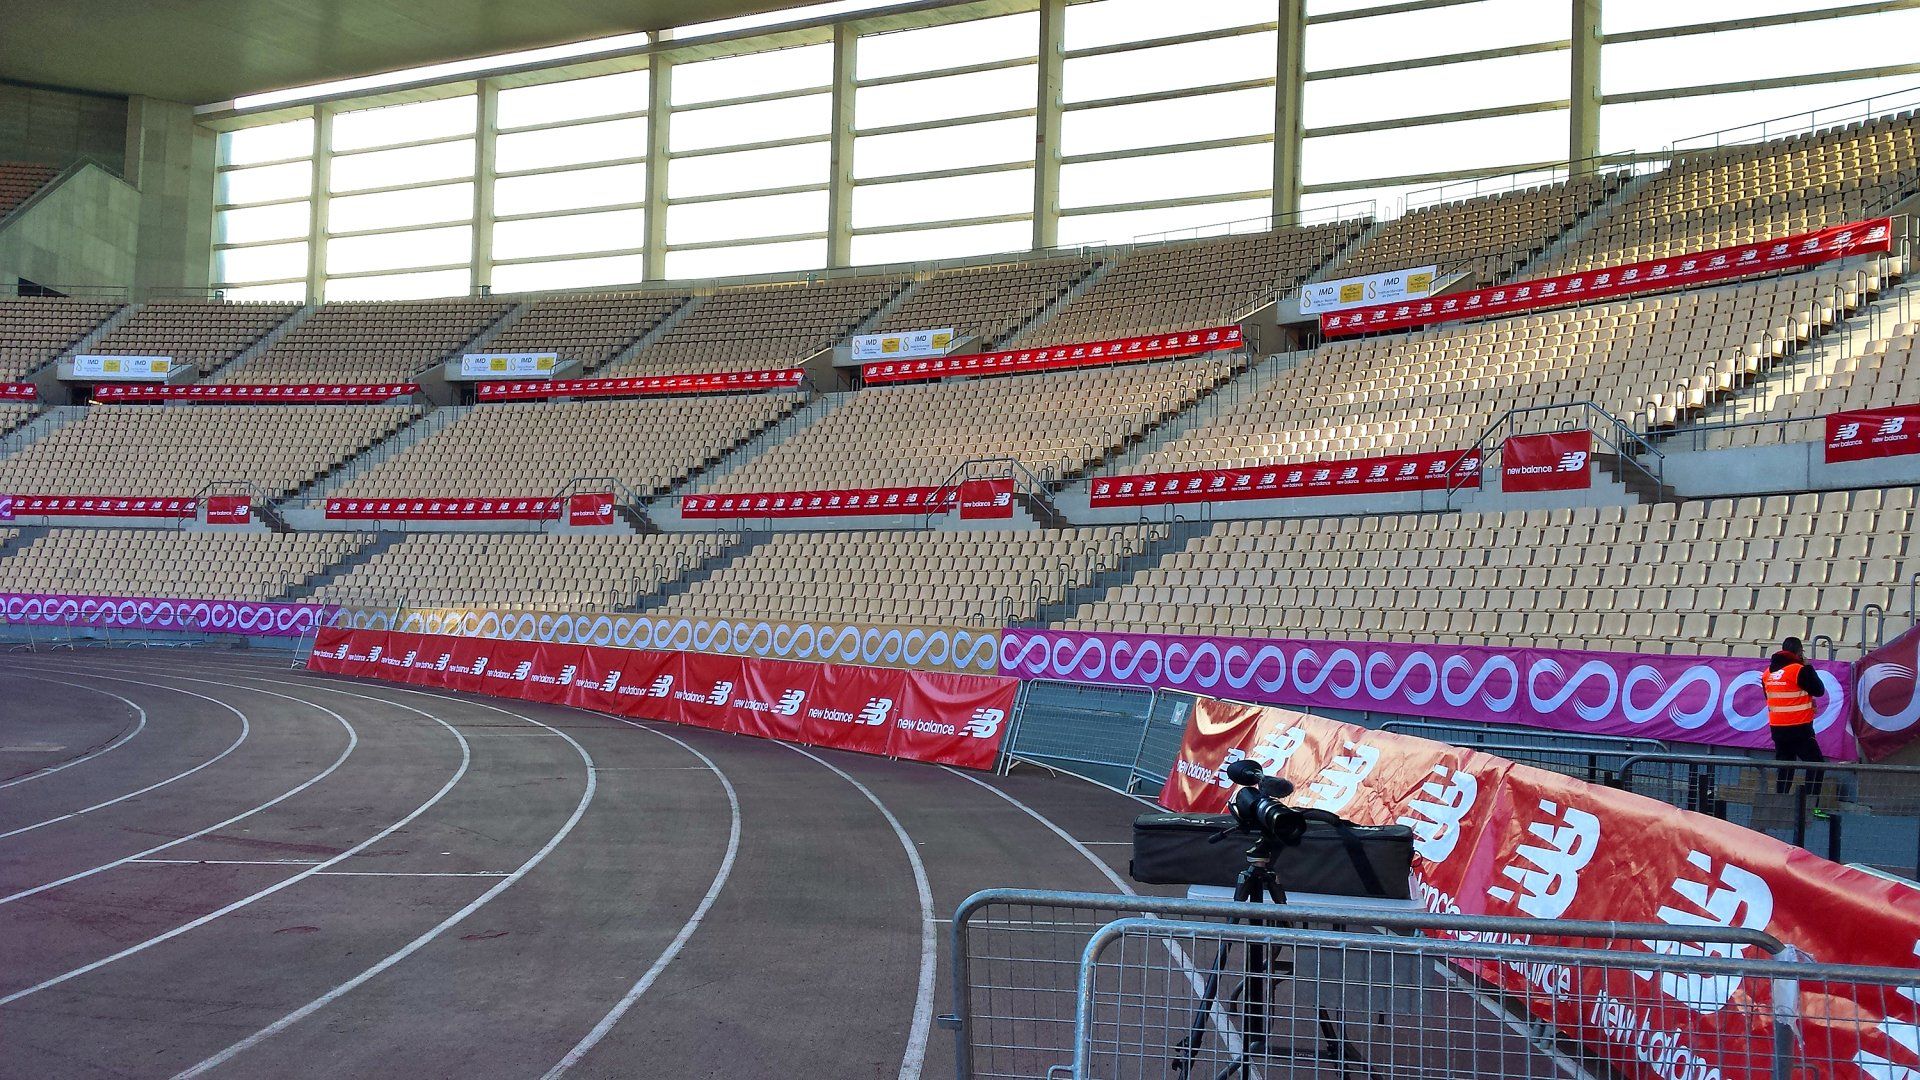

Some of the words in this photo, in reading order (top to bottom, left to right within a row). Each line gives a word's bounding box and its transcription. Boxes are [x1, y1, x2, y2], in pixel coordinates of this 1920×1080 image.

[1384, 277, 1399, 286] IMD
[1319, 287, 1333, 296] IMD
[1884, 434, 1907, 442] balance
[1507, 467, 1520, 475] new
[1522, 464, 1552, 473] balance
[674, 691, 684, 699] new
[683, 690, 705, 703] balance
[733, 699, 745, 708] new
[745, 699, 768, 711] balance
[808, 708, 823, 718] new
[824, 708, 853, 722] balance
[898, 718, 916, 730] new
[916, 718, 955, 735] balance
[1177, 760, 1188, 774] new
[1188, 760, 1211, 782] balance
[1590, 989, 1636, 1047] new
